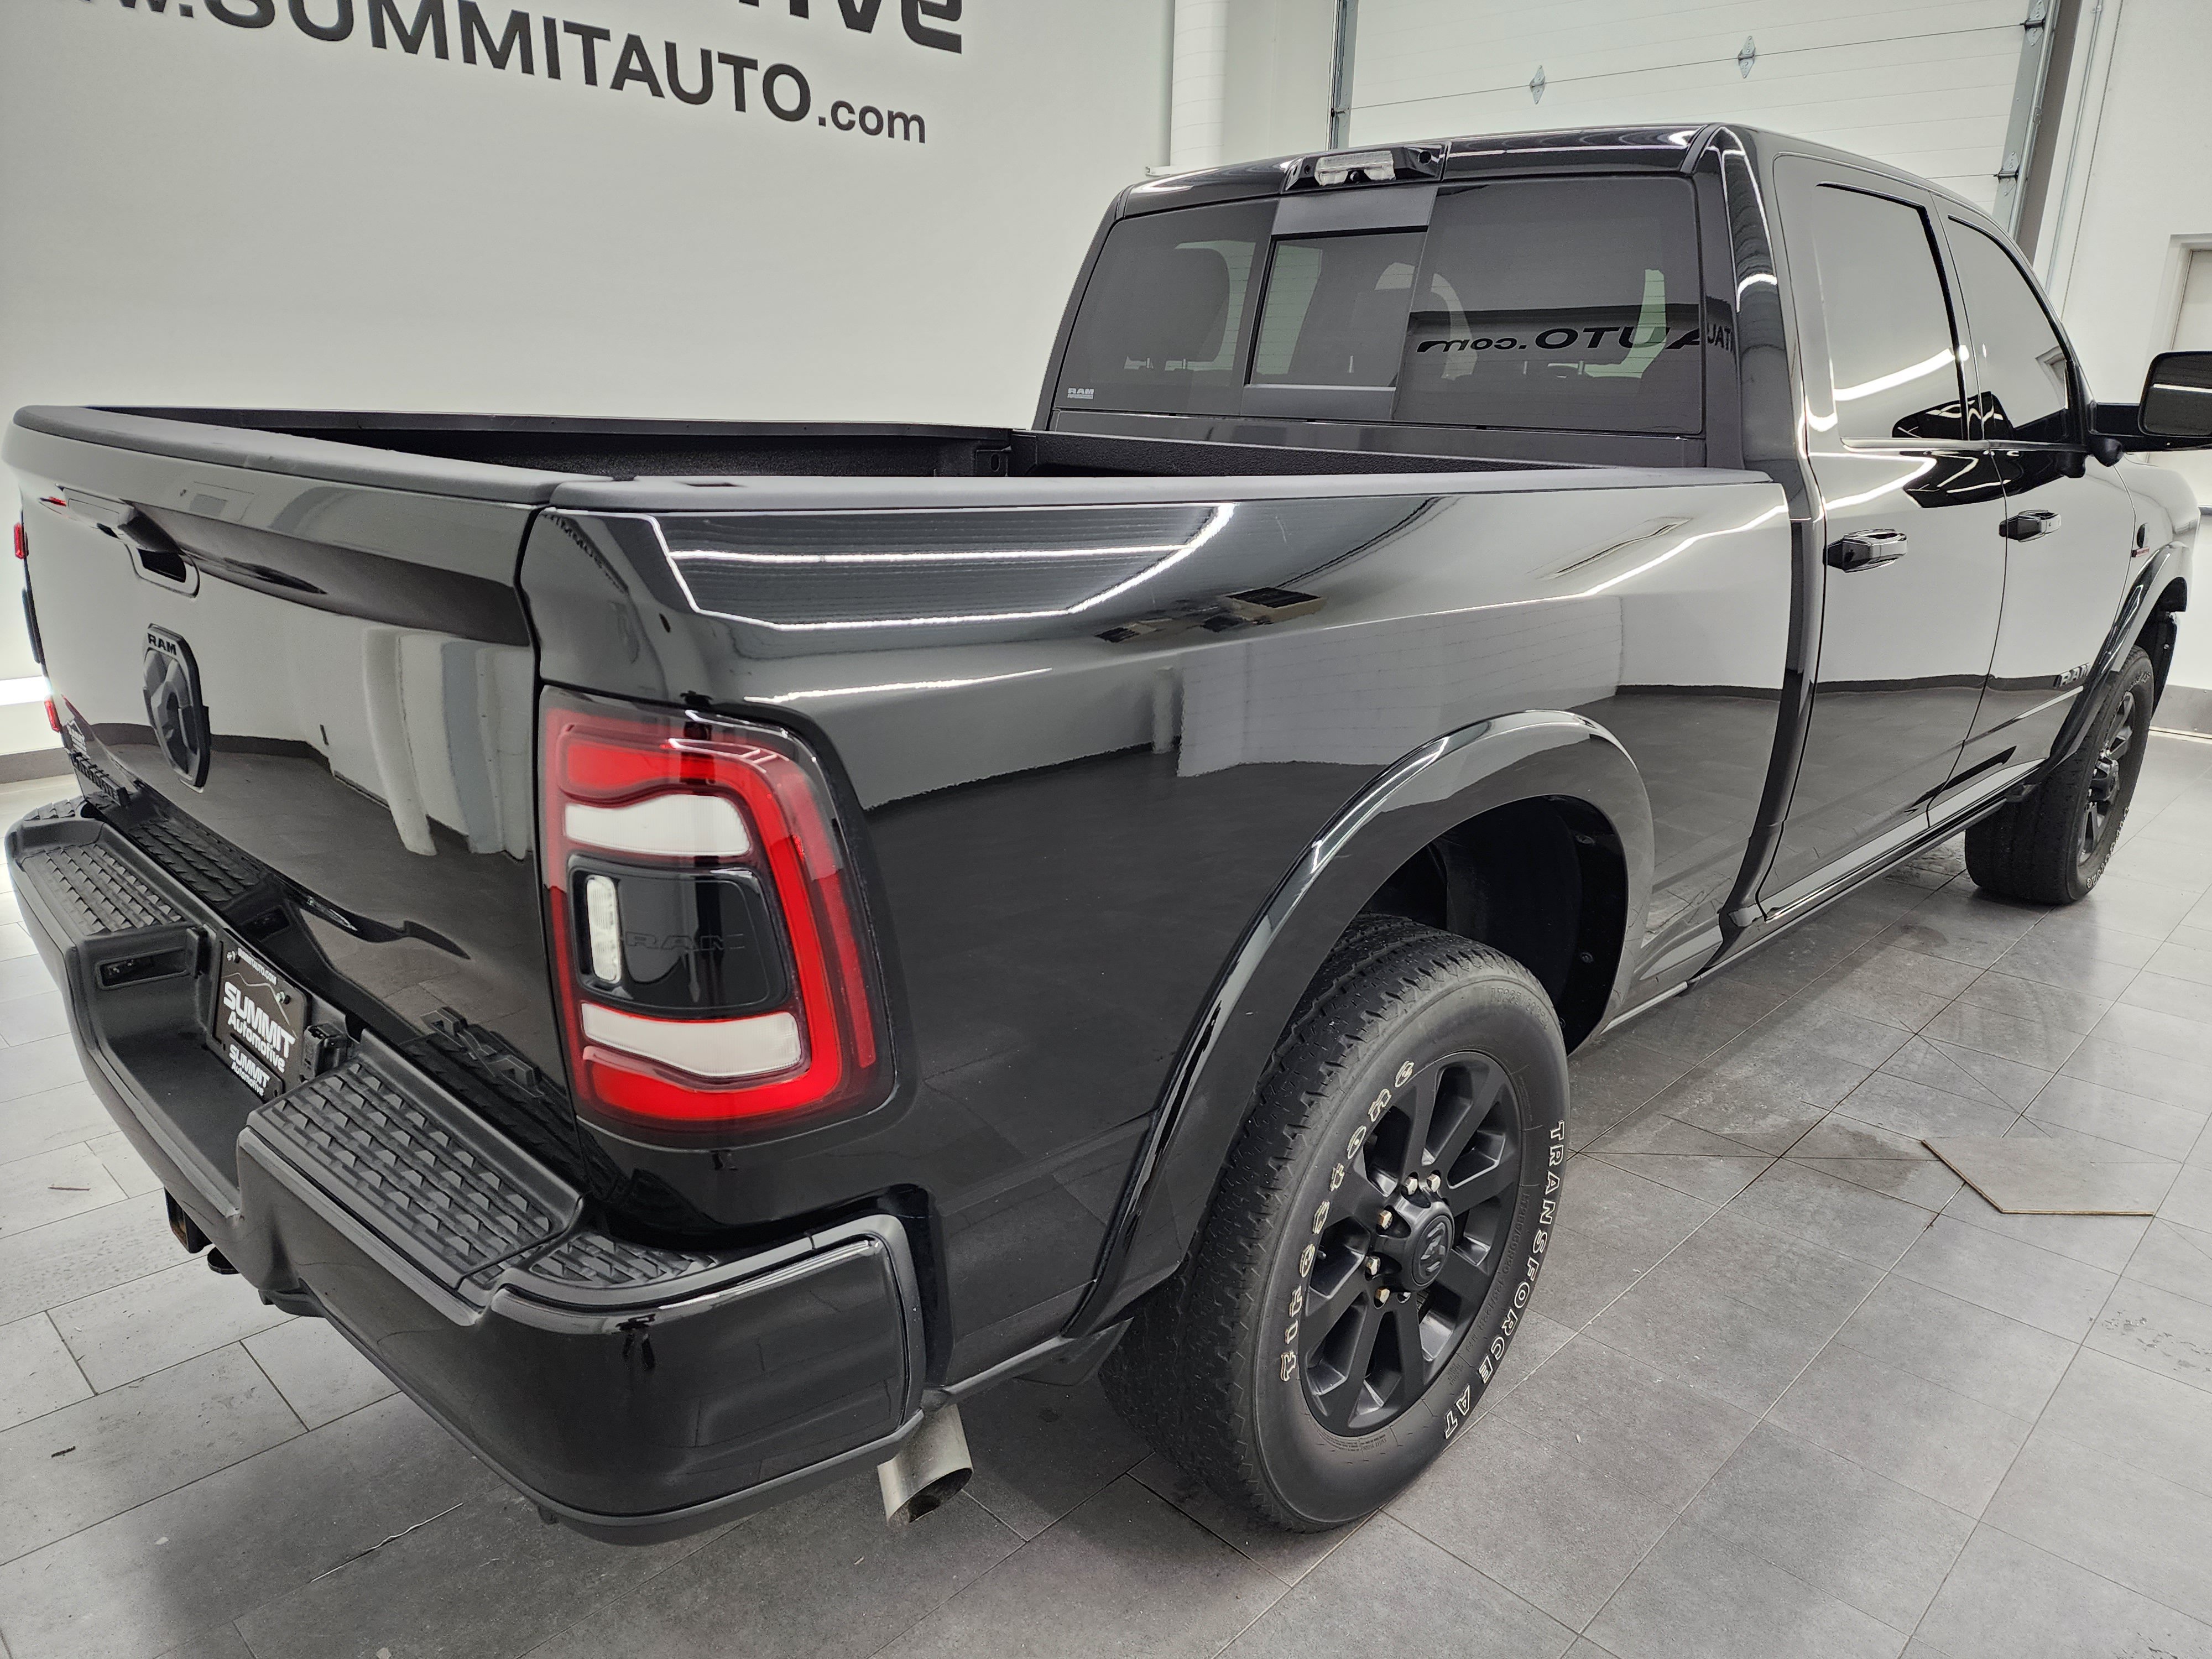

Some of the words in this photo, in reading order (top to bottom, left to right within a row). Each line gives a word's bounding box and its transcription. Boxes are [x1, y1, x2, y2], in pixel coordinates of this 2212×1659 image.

[148, 633, 177, 655] RAM
[223, 982, 296, 1058] SUMMIT
[227, 1011, 285, 1073] Automotive
[229, 1044, 270, 1088] SUMMIT
[231, 1061, 264, 1096] Automotive
[1478, 1119, 1565, 1385] TRANSFORCE
[1444, 1385, 1472, 1440] AT
